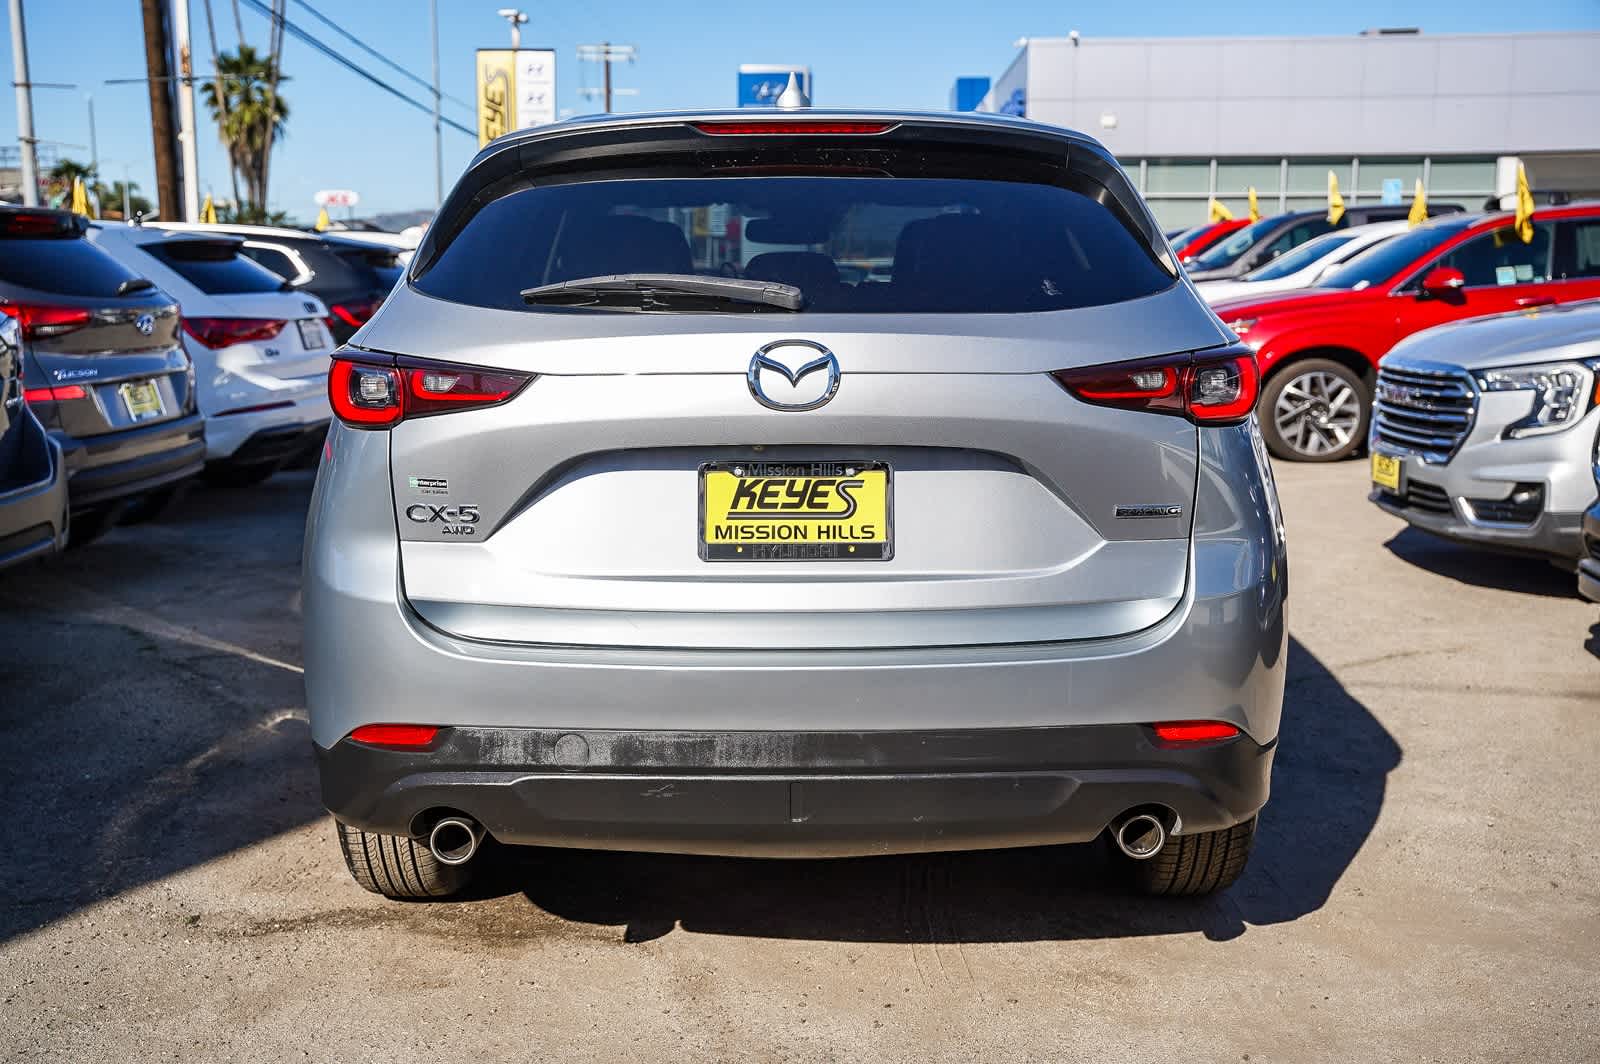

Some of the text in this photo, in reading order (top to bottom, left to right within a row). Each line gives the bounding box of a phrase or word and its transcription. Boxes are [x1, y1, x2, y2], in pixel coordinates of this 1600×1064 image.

[748, 463, 844, 476] Mission Hills
[727, 479, 865, 520] KEYES
[406, 503, 480, 524] CX-5
[442, 525, 475, 535] AWD
[714, 525, 875, 540] MISSION HILLS
